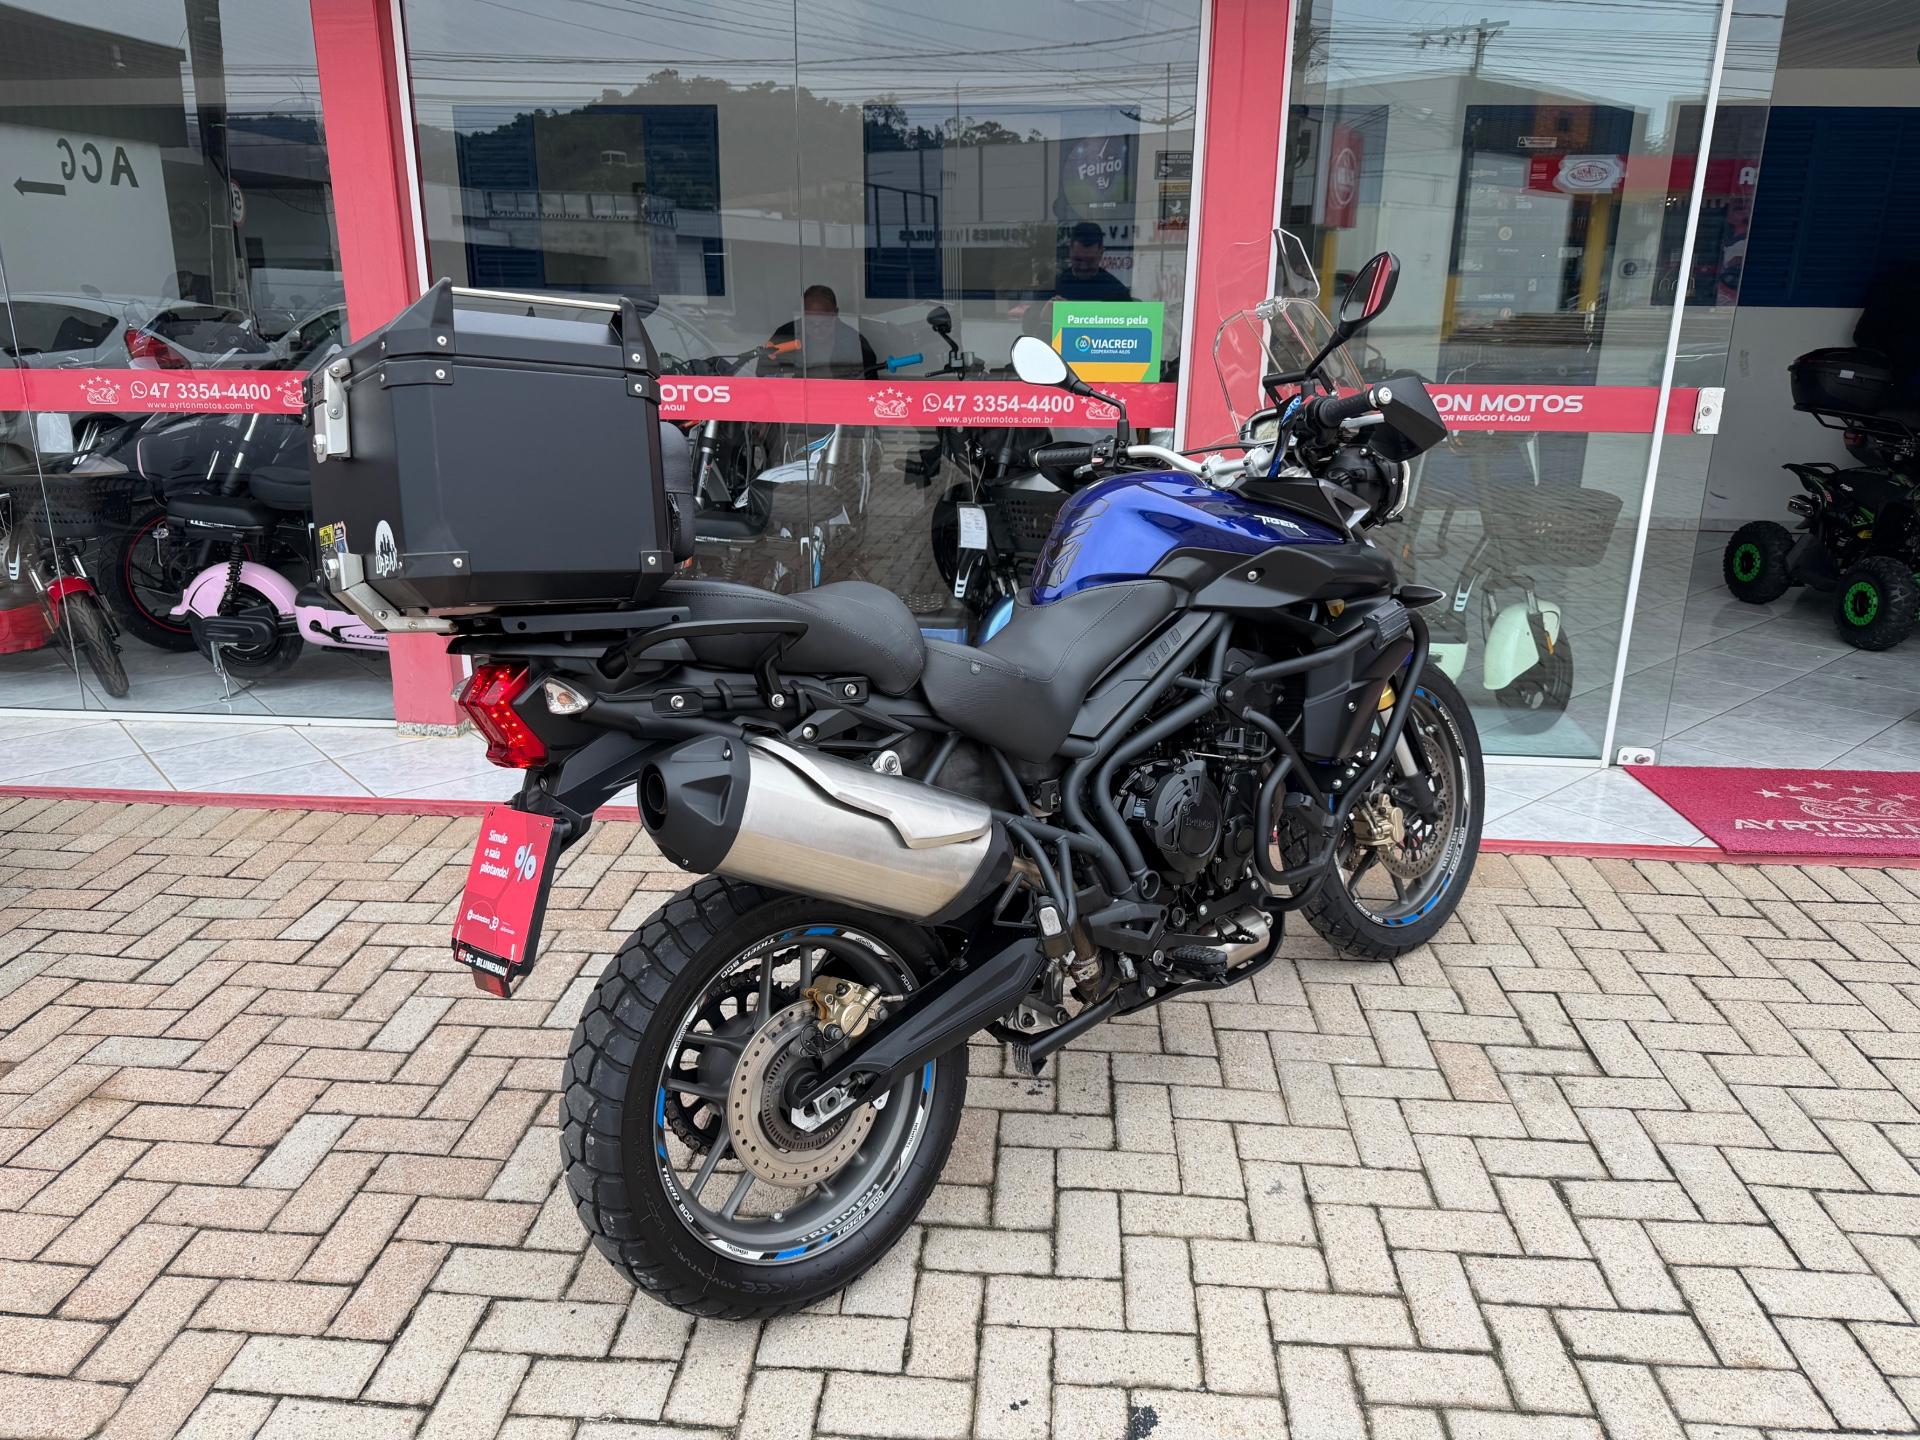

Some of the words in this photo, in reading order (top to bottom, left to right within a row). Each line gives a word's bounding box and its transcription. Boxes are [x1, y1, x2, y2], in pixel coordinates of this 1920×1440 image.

[1078, 155, 1123, 180] Feirão
[1067, 314, 1125, 325] Parcelamos
[1126, 315, 1149, 327] pela
[1091, 338, 1138, 349] VIACREDI
[149, 382, 171, 399] 47
[176, 382, 271, 401] 3354-4400
[659, 383, 732, 404] OTOS
[146, 400, 255, 411] www.ayrtonmotos.com.br
[663, 404, 686, 412] AQUI
[942, 394, 965, 412] 47
[972, 394, 1075, 413] 3354-4400
[1480, 393, 1585, 413] MOTOS
[937, 414, 1055, 425] www.ayrtonmotos.com.br
[1456, 413, 1498, 422] NEGÓCIO
[1499, 413, 1506, 422] É
[1253, 514, 1309, 537] TIGER
[1145, 628, 1182, 670] 800
[1734, 818, 1901, 834] AYRTON
[488, 829, 508, 845] Simule
[484, 847, 490, 857] e
[488, 847, 501, 860] saia
[1440, 826, 1460, 871] TRIUMPH
[479, 861, 510, 880] pilotando!
[514, 842, 537, 883] %
[742, 937, 776, 960] TIGER
[465, 952, 474, 963] SC
[476, 957, 508, 977] BLUMENAU
[720, 959, 740, 979] 800
[900, 973, 913, 992] 800
[661, 1164, 681, 1202] TIGER
[678, 1202, 694, 1223] 800
[796, 1183, 880, 1242] TRIUMPH
[836, 1209, 866, 1237] TIGER
[868, 1190, 885, 1211] 800
[726, 1243, 749, 1255] TRIUMPH
